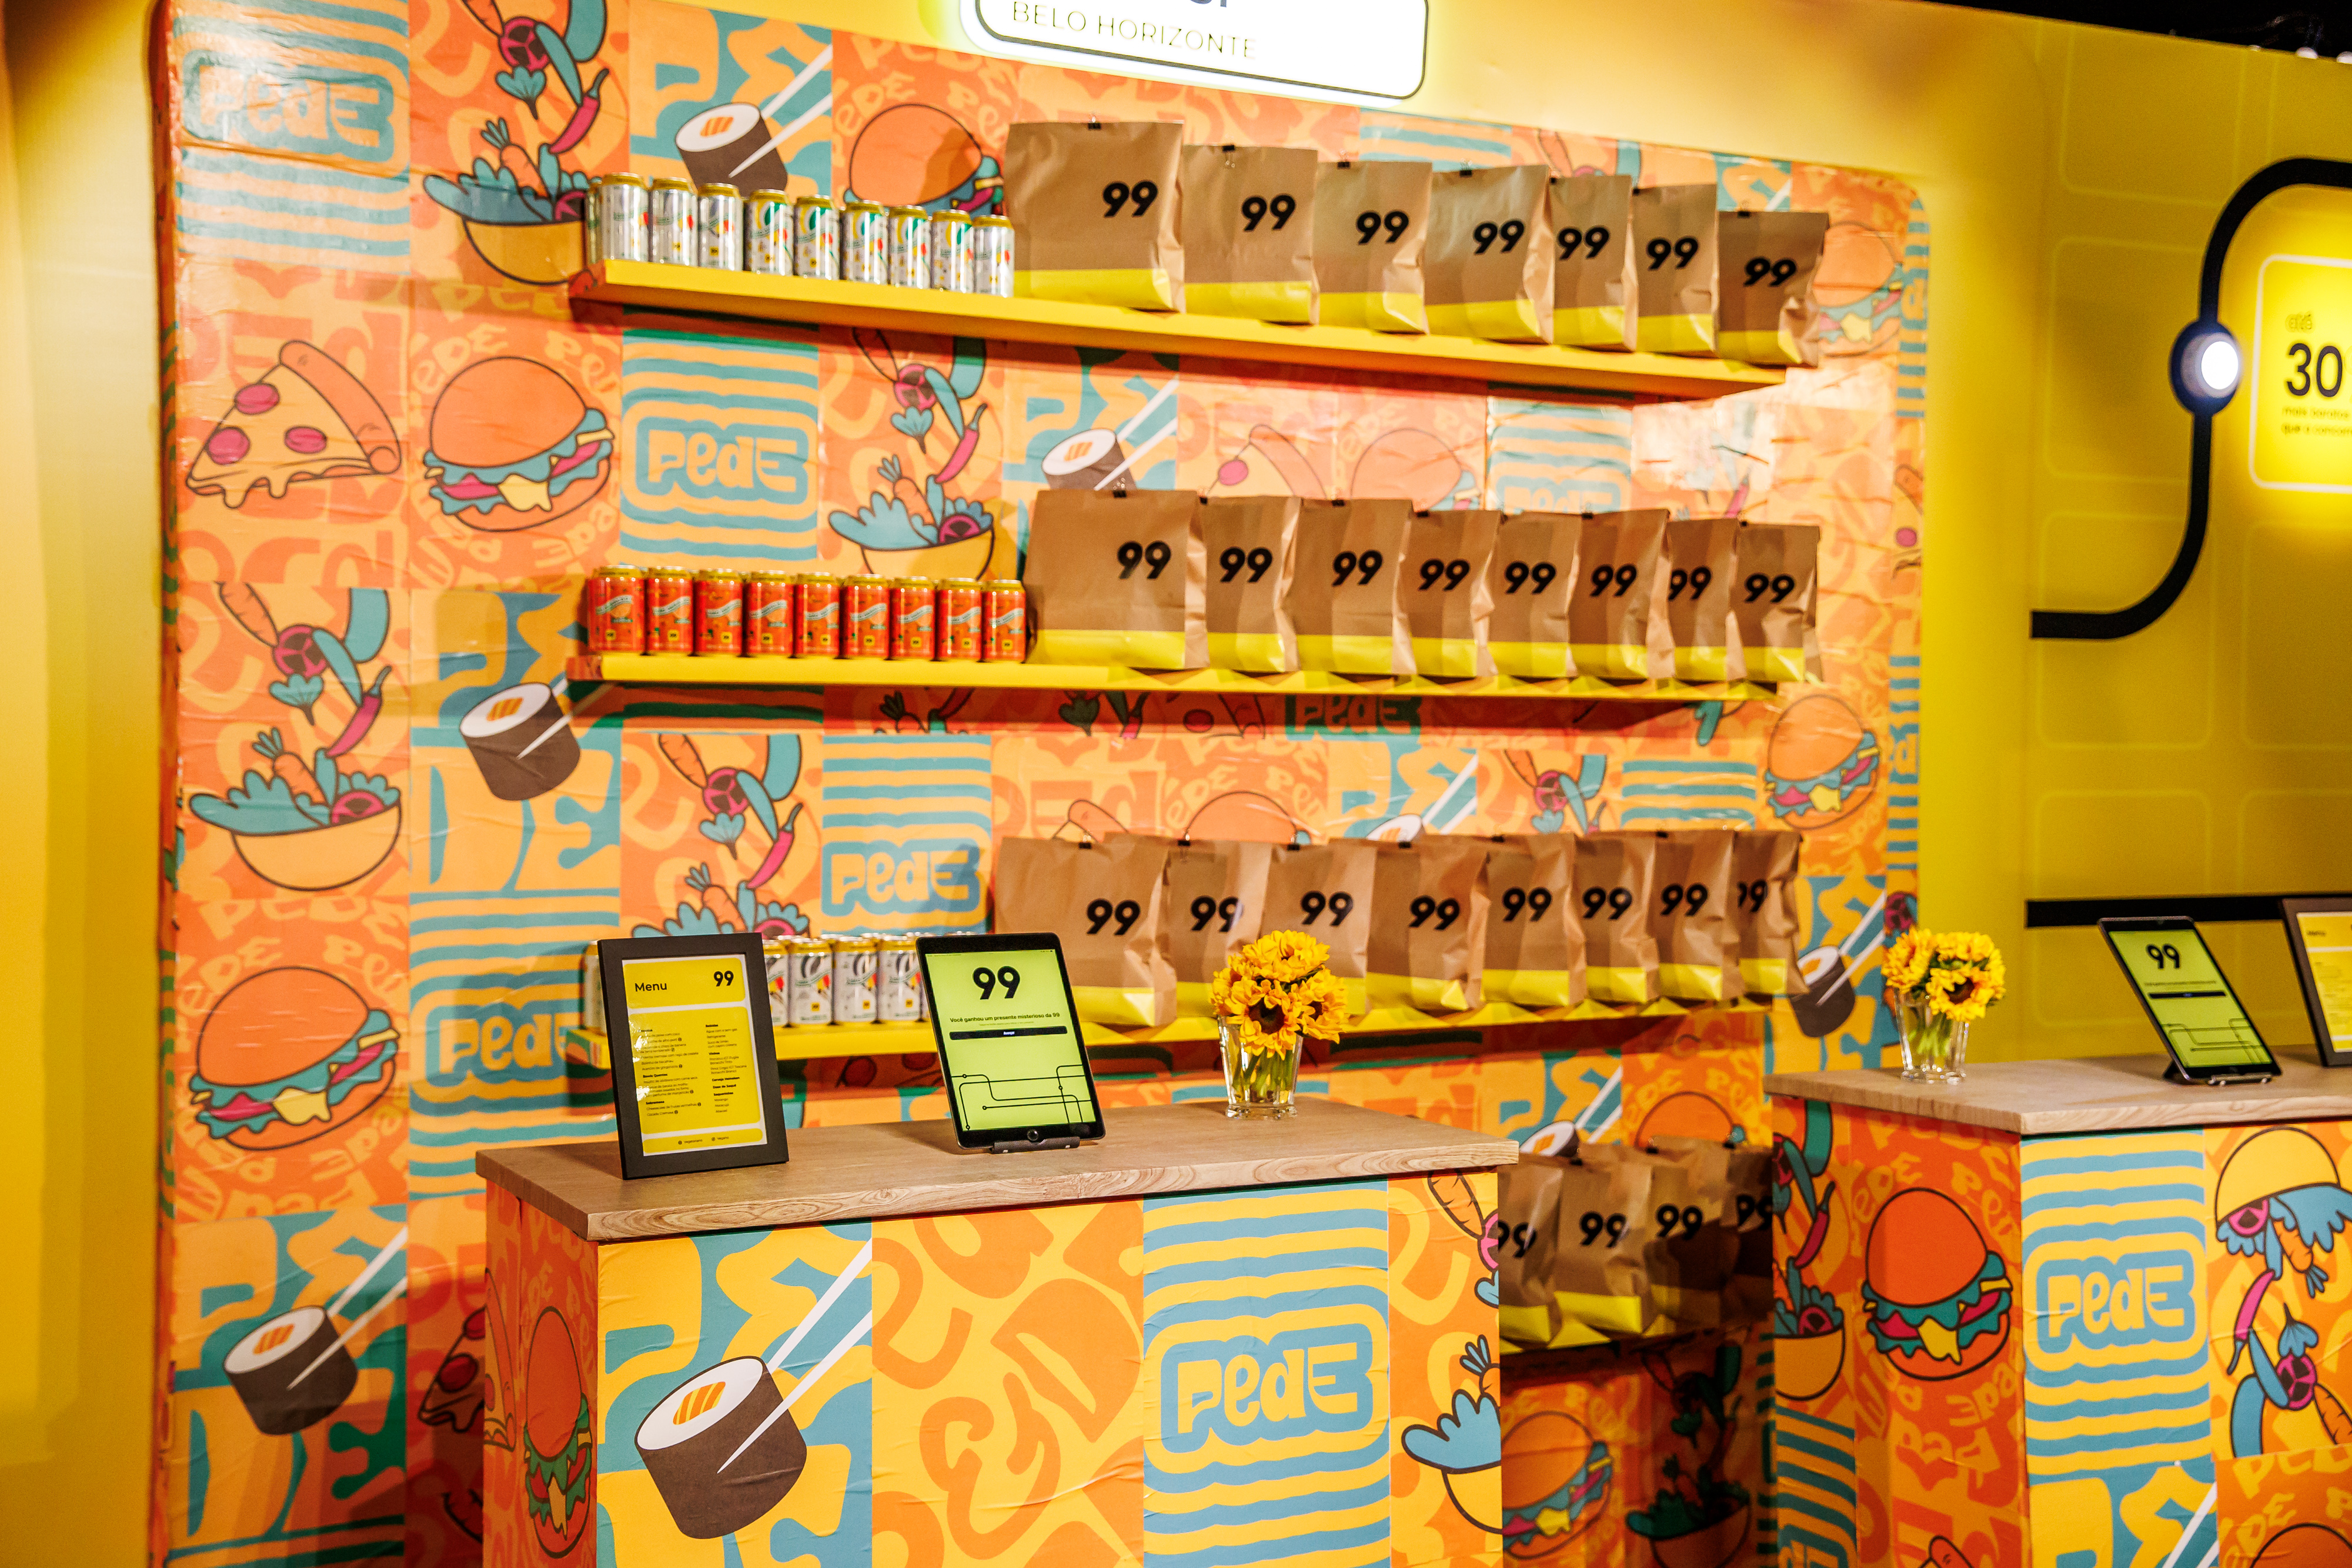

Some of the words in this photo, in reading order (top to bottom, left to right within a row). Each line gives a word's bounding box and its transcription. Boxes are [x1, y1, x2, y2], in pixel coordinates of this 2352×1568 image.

[1014, 1, 1087, 32] BELO
[1098, 15, 1257, 61] HORIZONTE
[1103, 181, 1158, 217] 99
[1242, 195, 1295, 231] 99
[1357, 211, 1409, 244] 99
[1474, 220, 1524, 254] 99
[1558, 227, 1609, 260] 99
[1647, 238, 1698, 270] 99
[1744, 258, 1796, 286] 99
[1117, 541, 1171, 579] 99
[1220, 547, 1272, 583] 99
[1332, 550, 1382, 586] 99
[1419, 560, 1469, 591] 99
[1505, 561, 1556, 594] 99
[1591, 564, 1636, 597] 99
[1745, 574, 1795, 603] 99
[1191, 896, 1243, 932] 99
[1301, 891, 1352, 926] 99
[1409, 896, 1460, 930] 99
[1502, 888, 1551, 922] 99
[1583, 887, 1632, 920] 99
[1661, 884, 1708, 916] 99
[1087, 900, 1140, 935] 99
[2146, 944, 2180, 969] 99
[634, 982, 667, 992] Menu
[713, 971, 734, 987] 99
[973, 966, 1020, 999] 99
[1580, 1212, 1628, 1248] 99
[1657, 1205, 1703, 1240] 99
